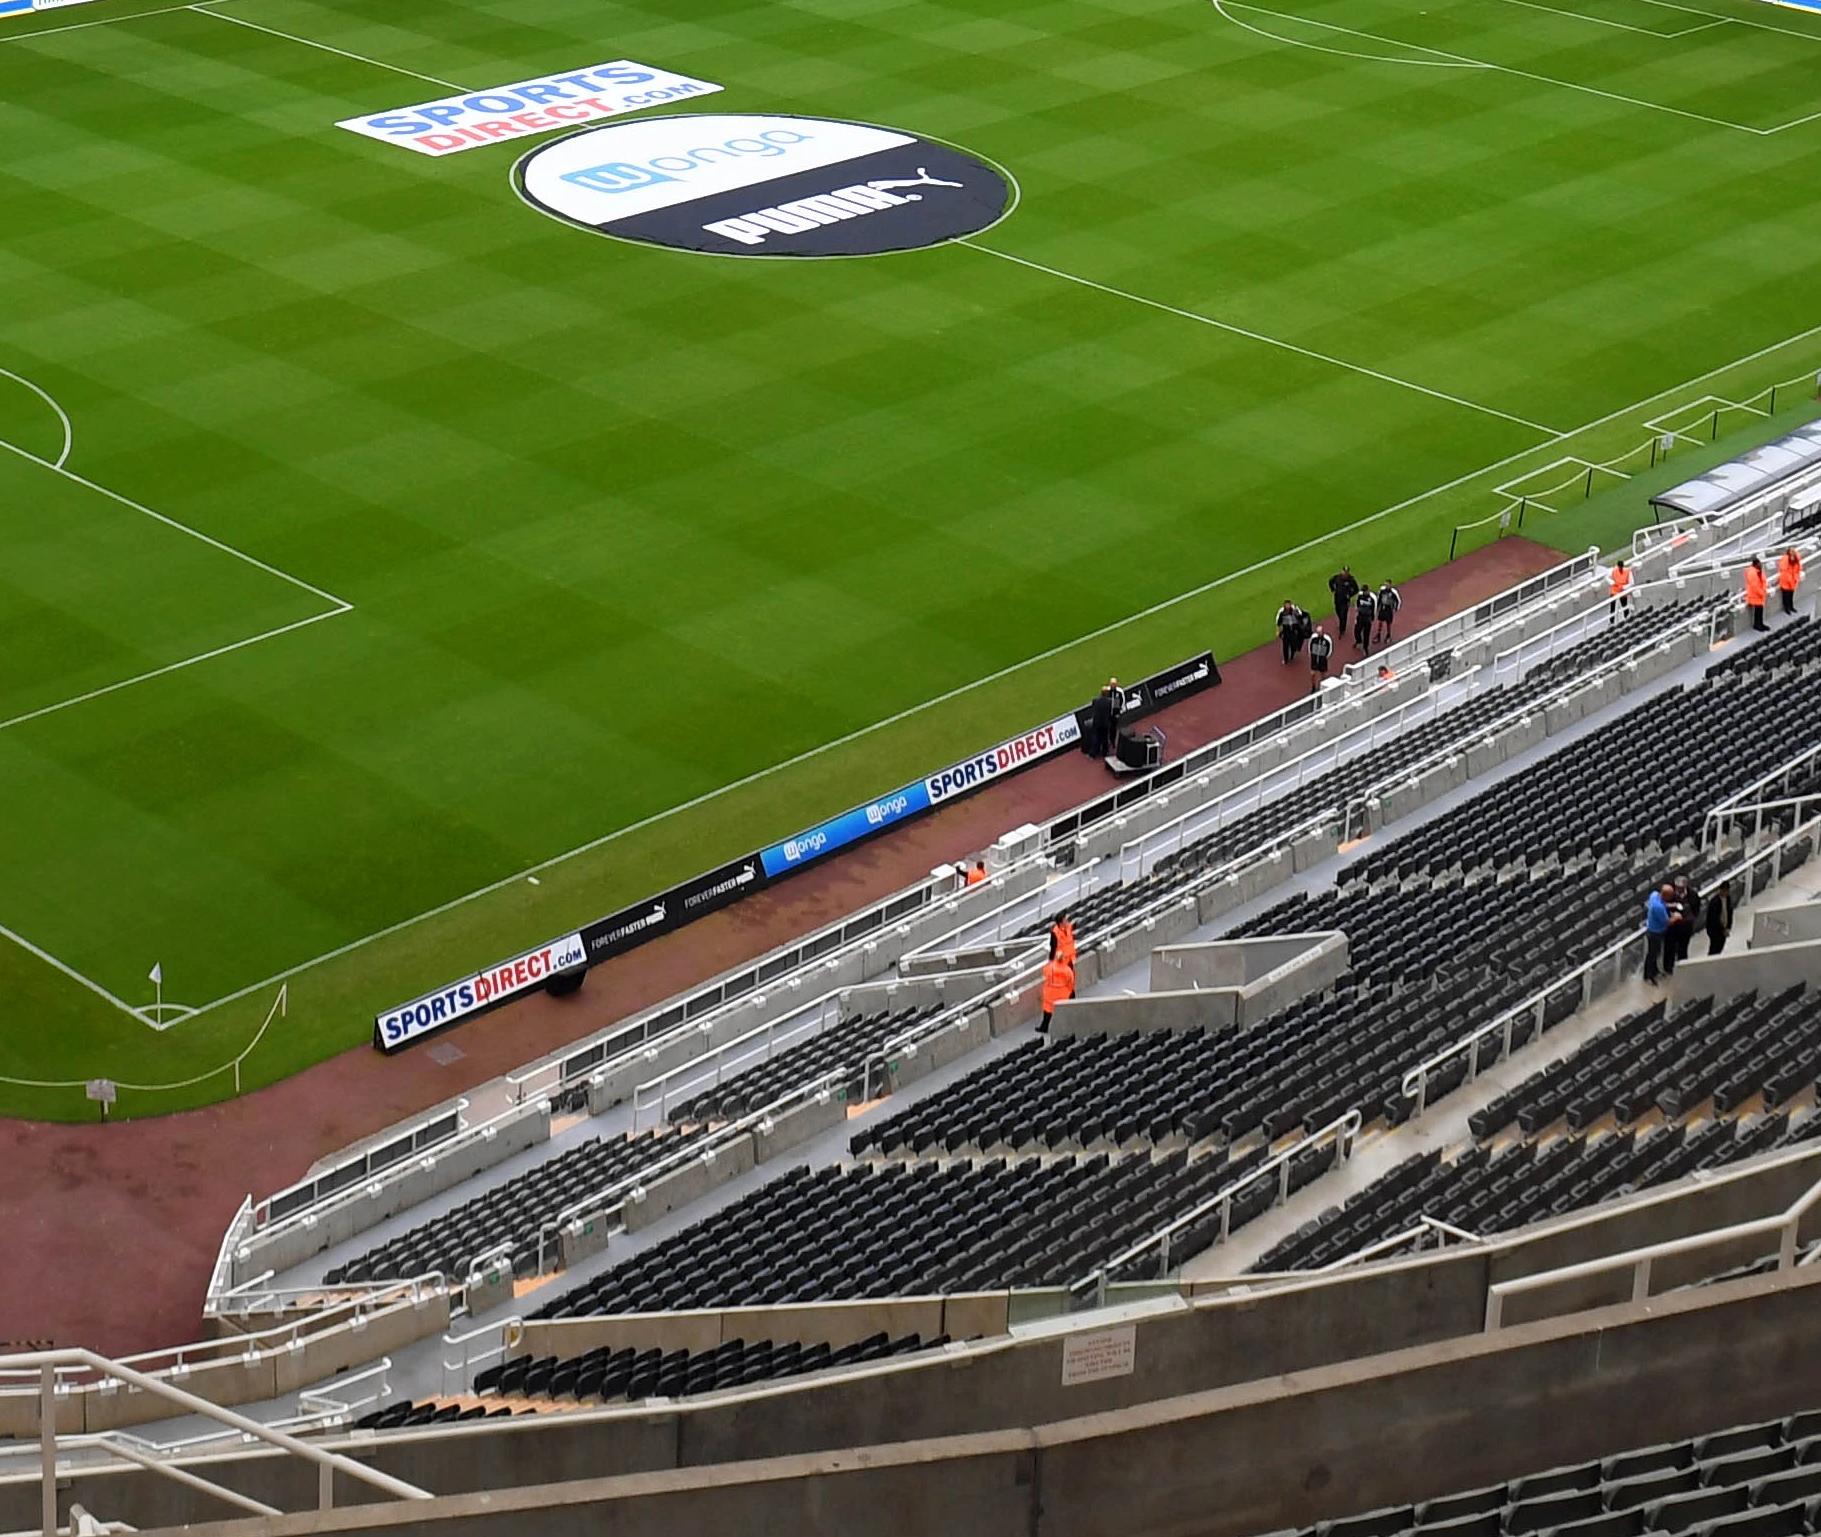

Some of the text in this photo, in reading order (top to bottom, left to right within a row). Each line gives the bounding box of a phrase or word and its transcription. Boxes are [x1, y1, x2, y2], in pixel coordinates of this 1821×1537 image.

[368, 62, 657, 137] SPORTS
[558, 127, 815, 196] wonga
[702, 182, 914, 245] PUMA
[930, 726, 1078, 799] SPORTSDIRECT.COM
[783, 794, 908, 863] wonga wonga
[386, 948, 582, 1041] SPORTSDIRECT.COM
